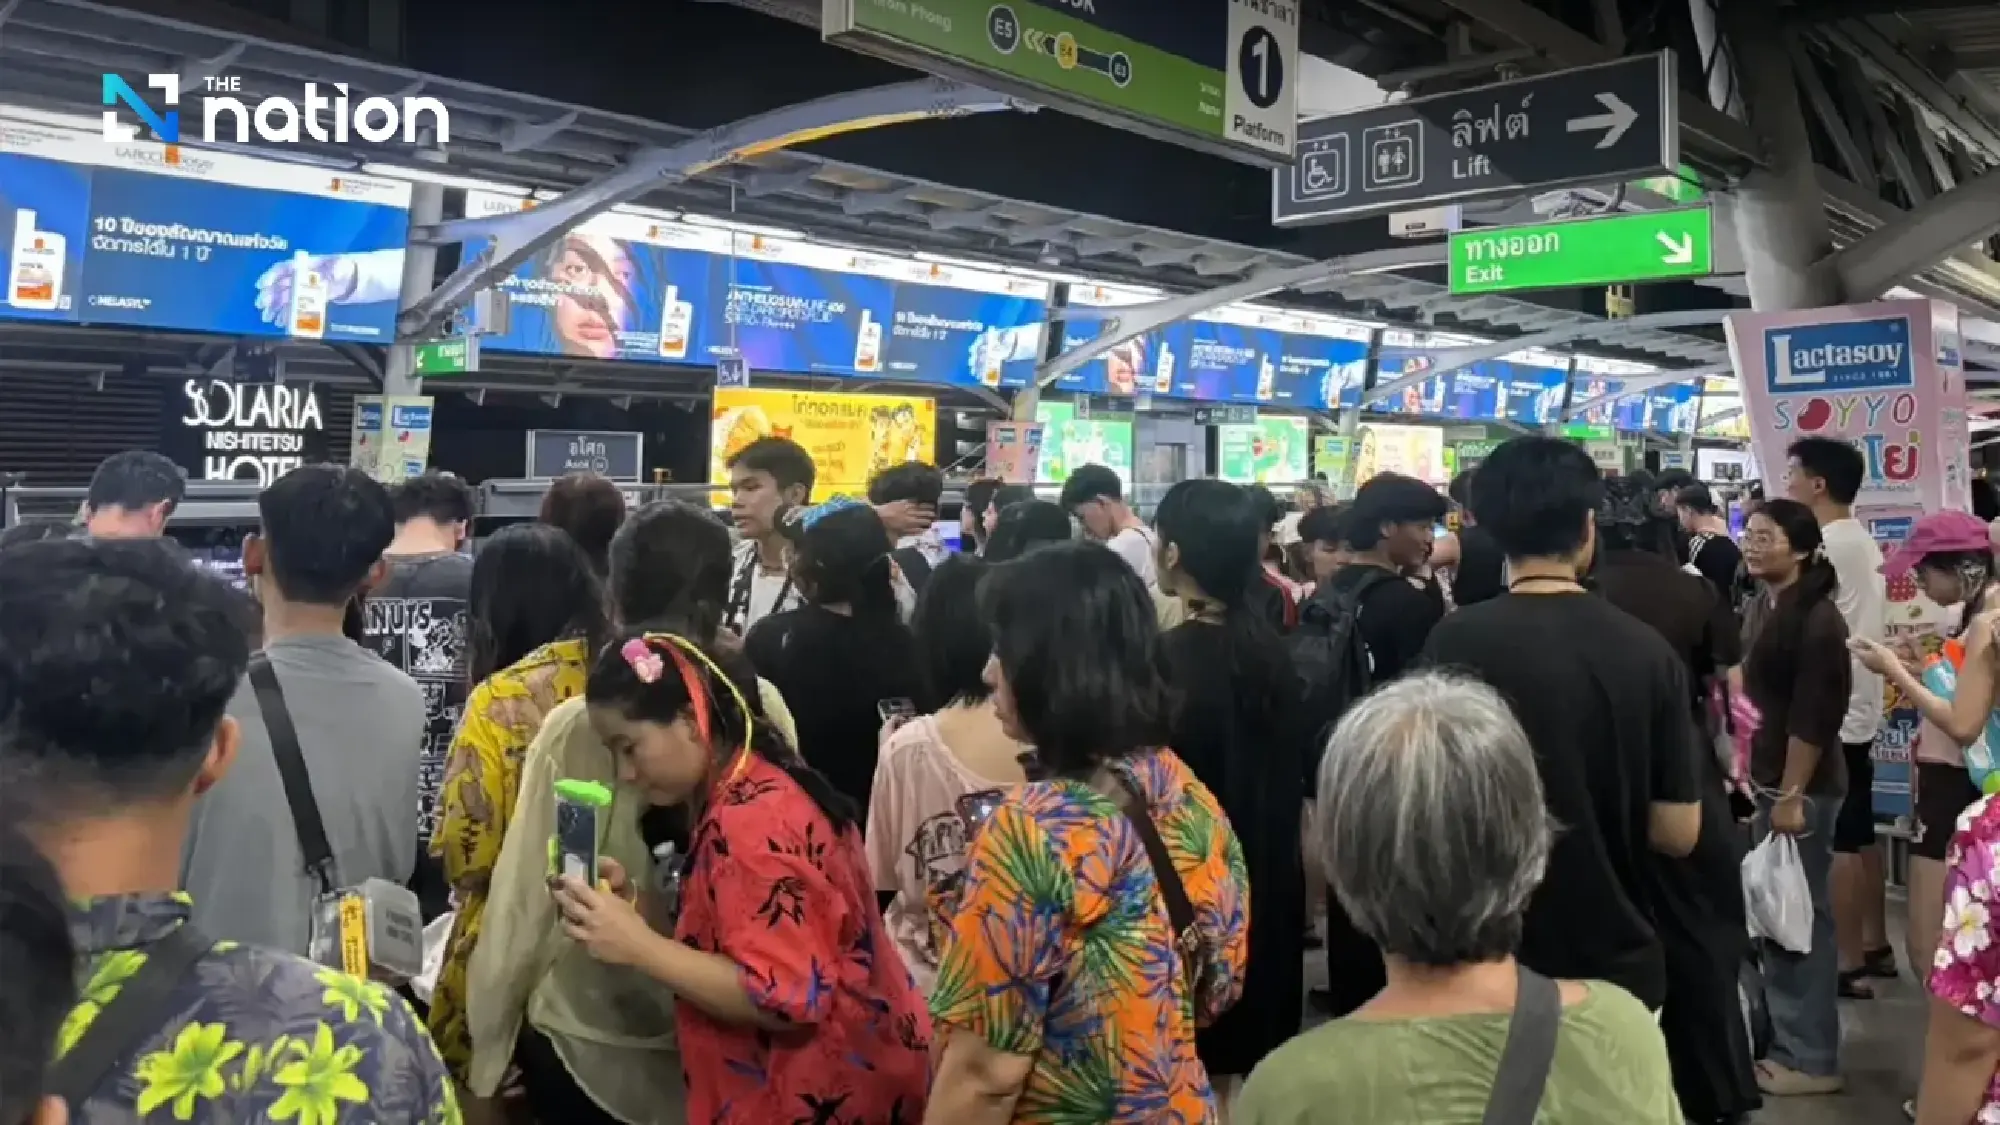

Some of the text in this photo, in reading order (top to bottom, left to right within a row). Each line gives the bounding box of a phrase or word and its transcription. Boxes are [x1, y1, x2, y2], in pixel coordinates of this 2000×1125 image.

[910, 3, 952, 32] Phong
[994, 17, 1013, 38] E5
[1252, 34, 1269, 98] 1
[1233, 114, 1285, 146] Platform
[1452, 93, 1534, 149] ลิฟต์
[1453, 154, 1491, 180] Lift
[93, 217, 116, 232] 10
[1464, 231, 1560, 262] ทางออก
[1465, 265, 1504, 282] Exit
[1771, 333, 1904, 385] Lactasoy
[182, 378, 324, 430] SOLARIA
[205, 431, 303, 452] NISHITETSU
[363, 600, 432, 636] NUTS
